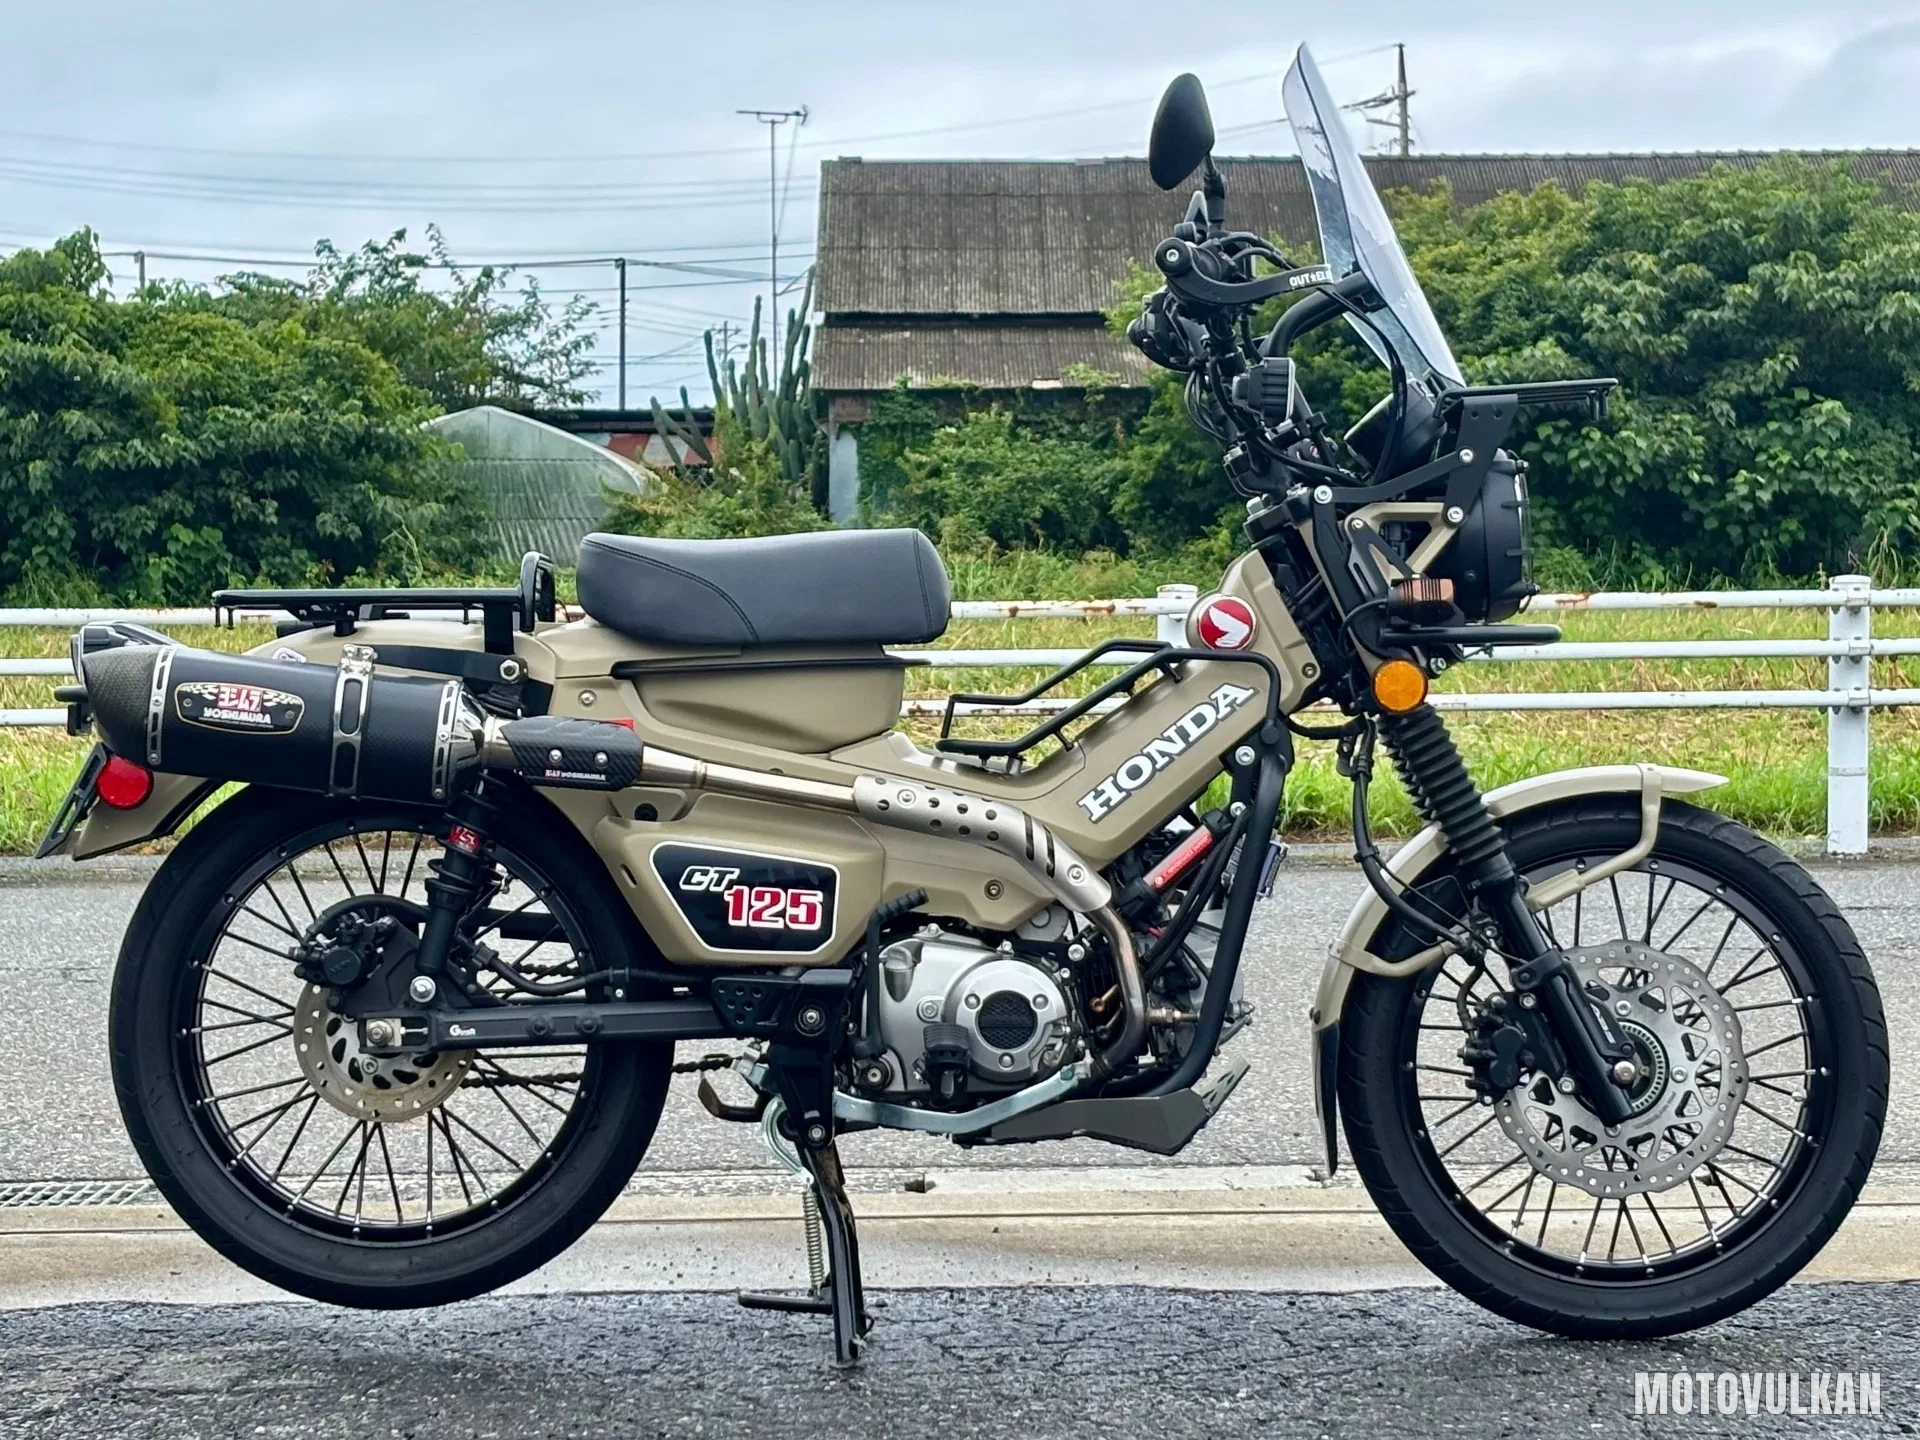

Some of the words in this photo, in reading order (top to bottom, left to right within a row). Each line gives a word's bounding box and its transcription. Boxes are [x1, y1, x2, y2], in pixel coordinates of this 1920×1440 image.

[203, 706, 272, 725] YOSHIMURA
[1077, 683, 1257, 823] HONDA
[679, 866, 740, 892] CT
[724, 885, 823, 931] 125
